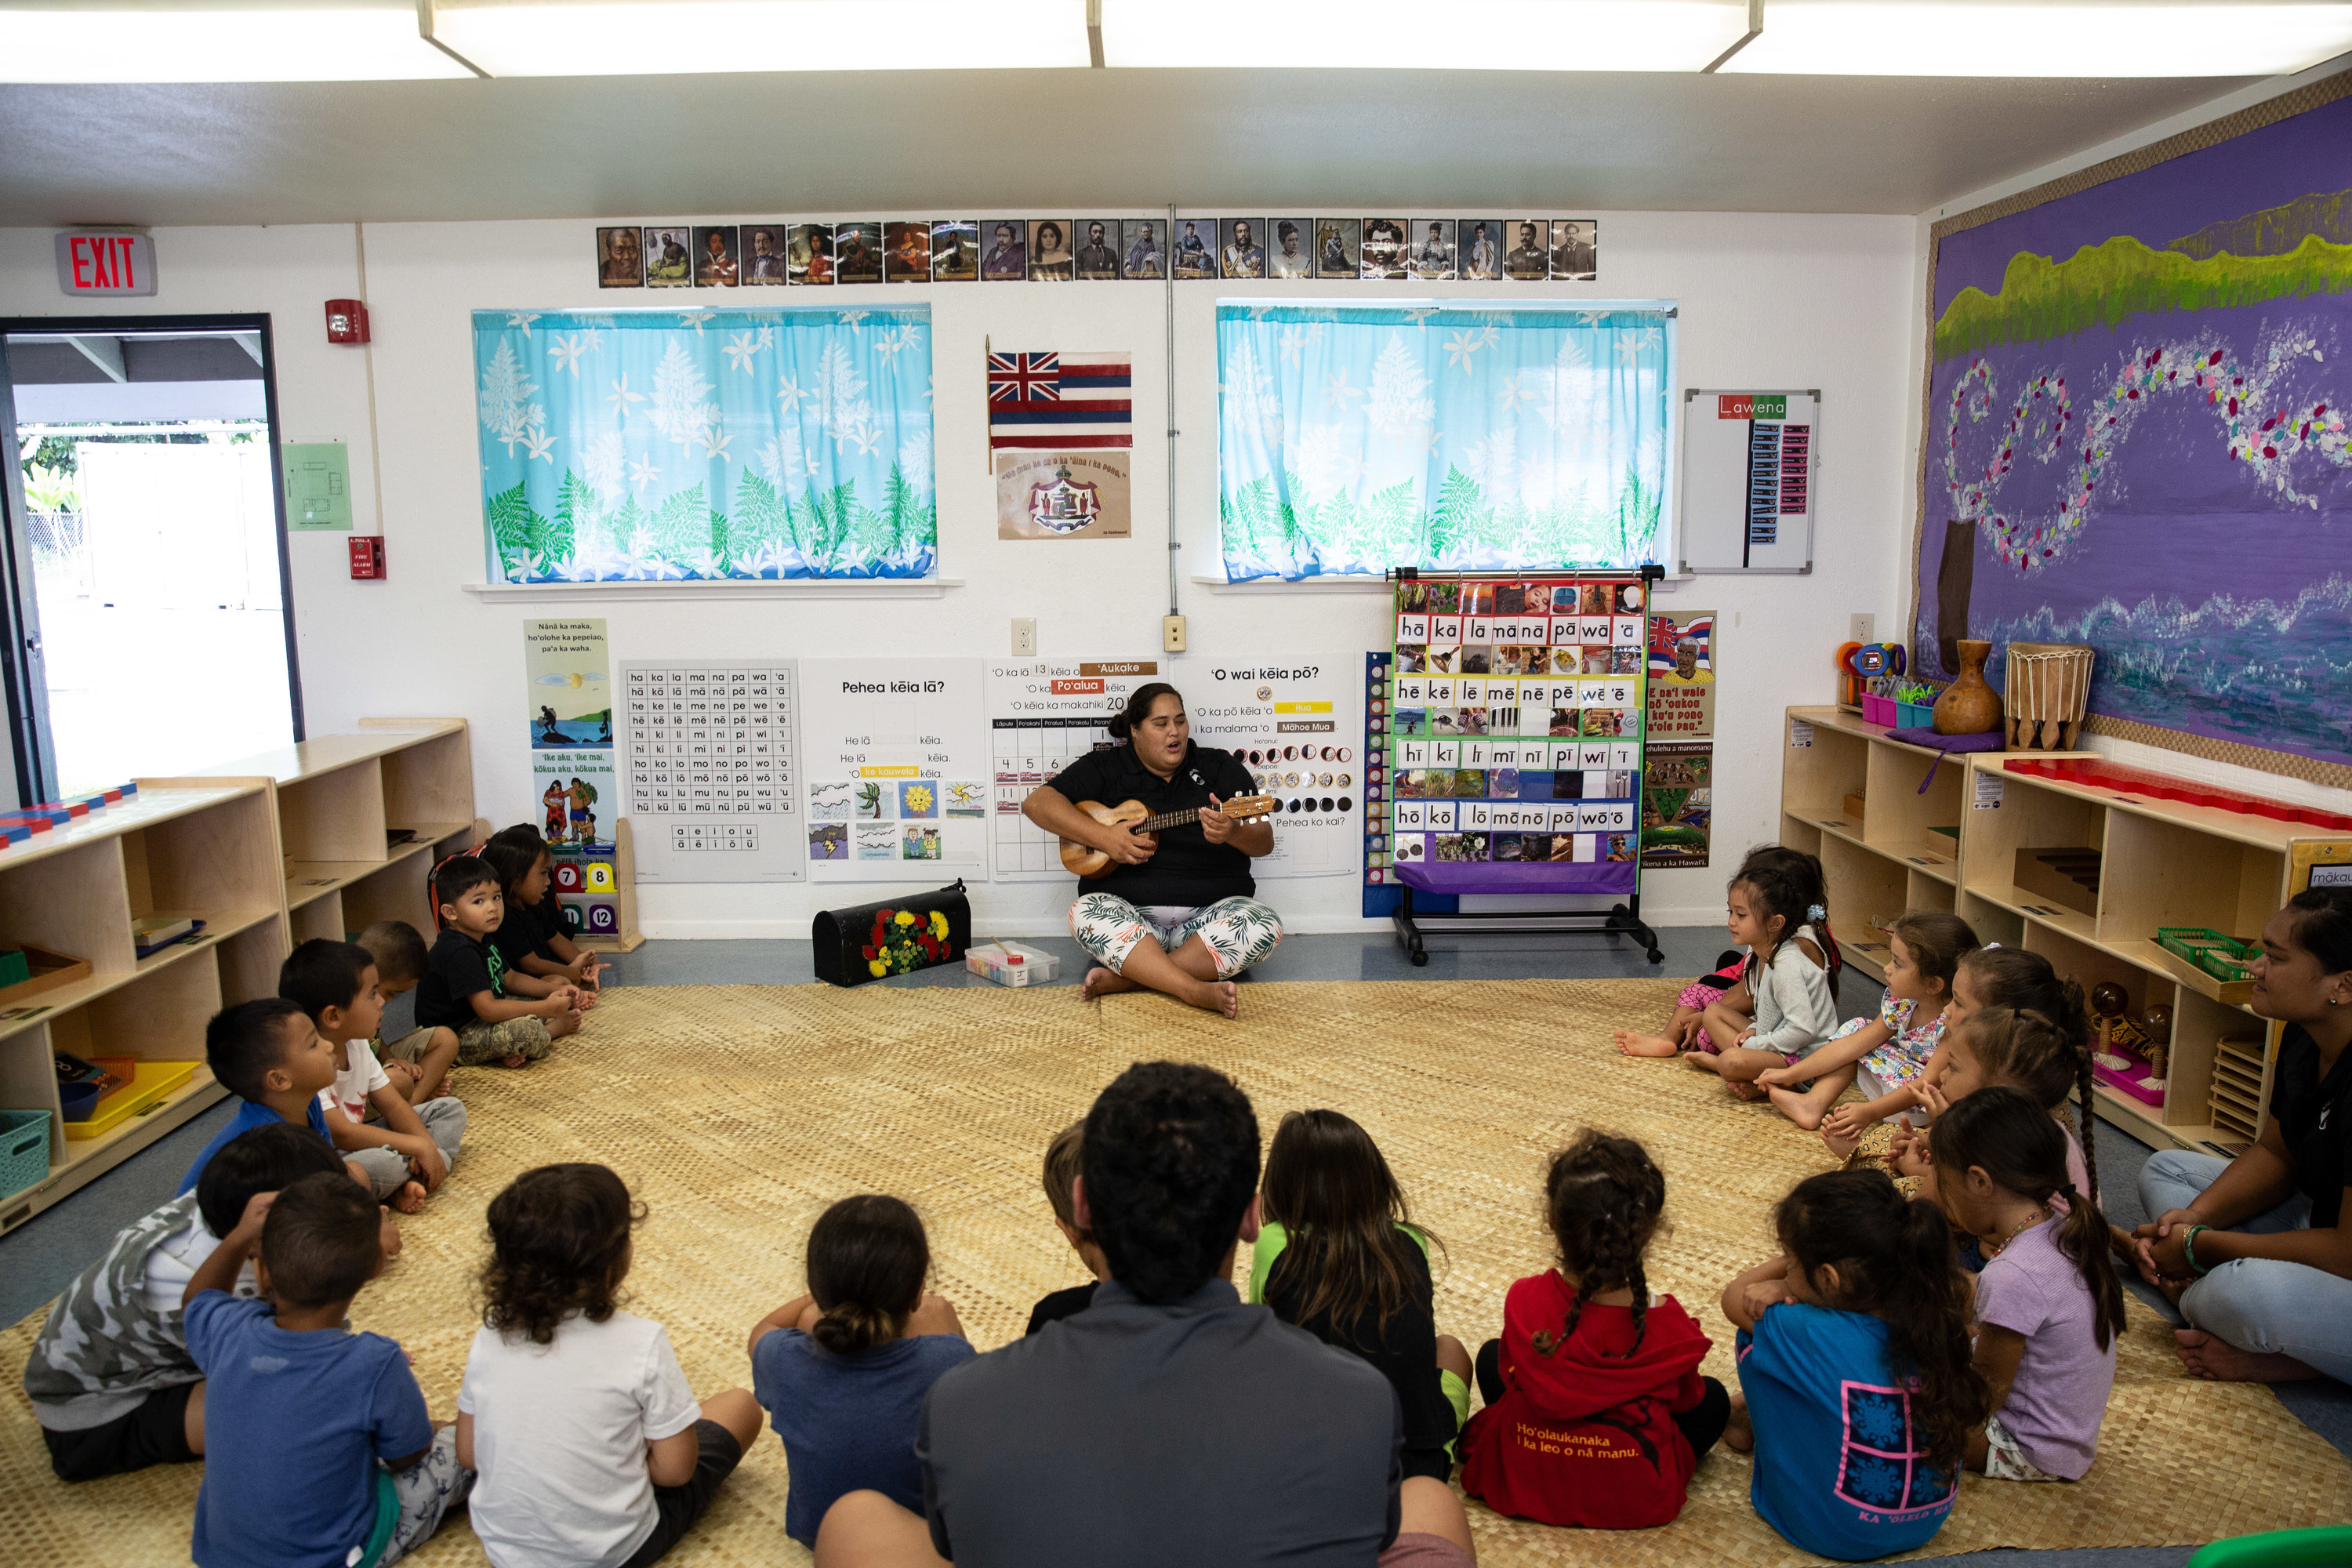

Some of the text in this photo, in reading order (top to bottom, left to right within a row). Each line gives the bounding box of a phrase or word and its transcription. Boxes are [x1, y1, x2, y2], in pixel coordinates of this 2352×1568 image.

[70, 238, 133, 288] EXIT
[1721, 397, 1784, 413] Lawena
[1403, 617, 1424, 636] hā
[1436, 619, 1456, 637] kā
[1471, 619, 1485, 637] lā
[1493, 626, 1516, 638] mā
[1522, 626, 1543, 637] nā
[1555, 623, 1576, 644] pā
[1582, 625, 1608, 637] wā
[1036, 665, 1045, 673] 13
[1231, 669, 1254, 680] wai
[1260, 668, 1288, 679] kēia
[1293, 667, 1319, 681] pō?
[843, 681, 944, 692] Pehea kēia lā?
[1399, 680, 1419, 699] hē
[1429, 680, 1449, 699] kē
[1464, 681, 1477, 699] lē
[1488, 688, 1514, 700] mē
[1523, 688, 1543, 700] nē
[1553, 687, 1573, 707] pē
[1581, 689, 1604, 701] wē
[1682, 687, 1705, 697] wale
[1650, 699, 1661, 709] nō
[1225, 707, 1237, 717] pō
[1678, 711, 1703, 720] pono
[1102, 730, 1104, 739] 1
[862, 736, 869, 745] lā
[928, 753, 950, 762] kēia.
[1003, 759, 1058, 768] 4 5 6
[878, 768, 914, 776] kauwela
[1004, 789, 1012, 797] 11
[1327, 817, 1345, 826] kai?
[563, 871, 604, 883] 7 8
[597, 912, 609, 923] 12
[1524, 1437, 1536, 1450] ka
[1541, 1441, 1560, 1454] leo
[1578, 1448, 1593, 1457] nā
[1599, 1449, 1639, 1458] manu.
[1859, 1512, 1880, 1523] KA
